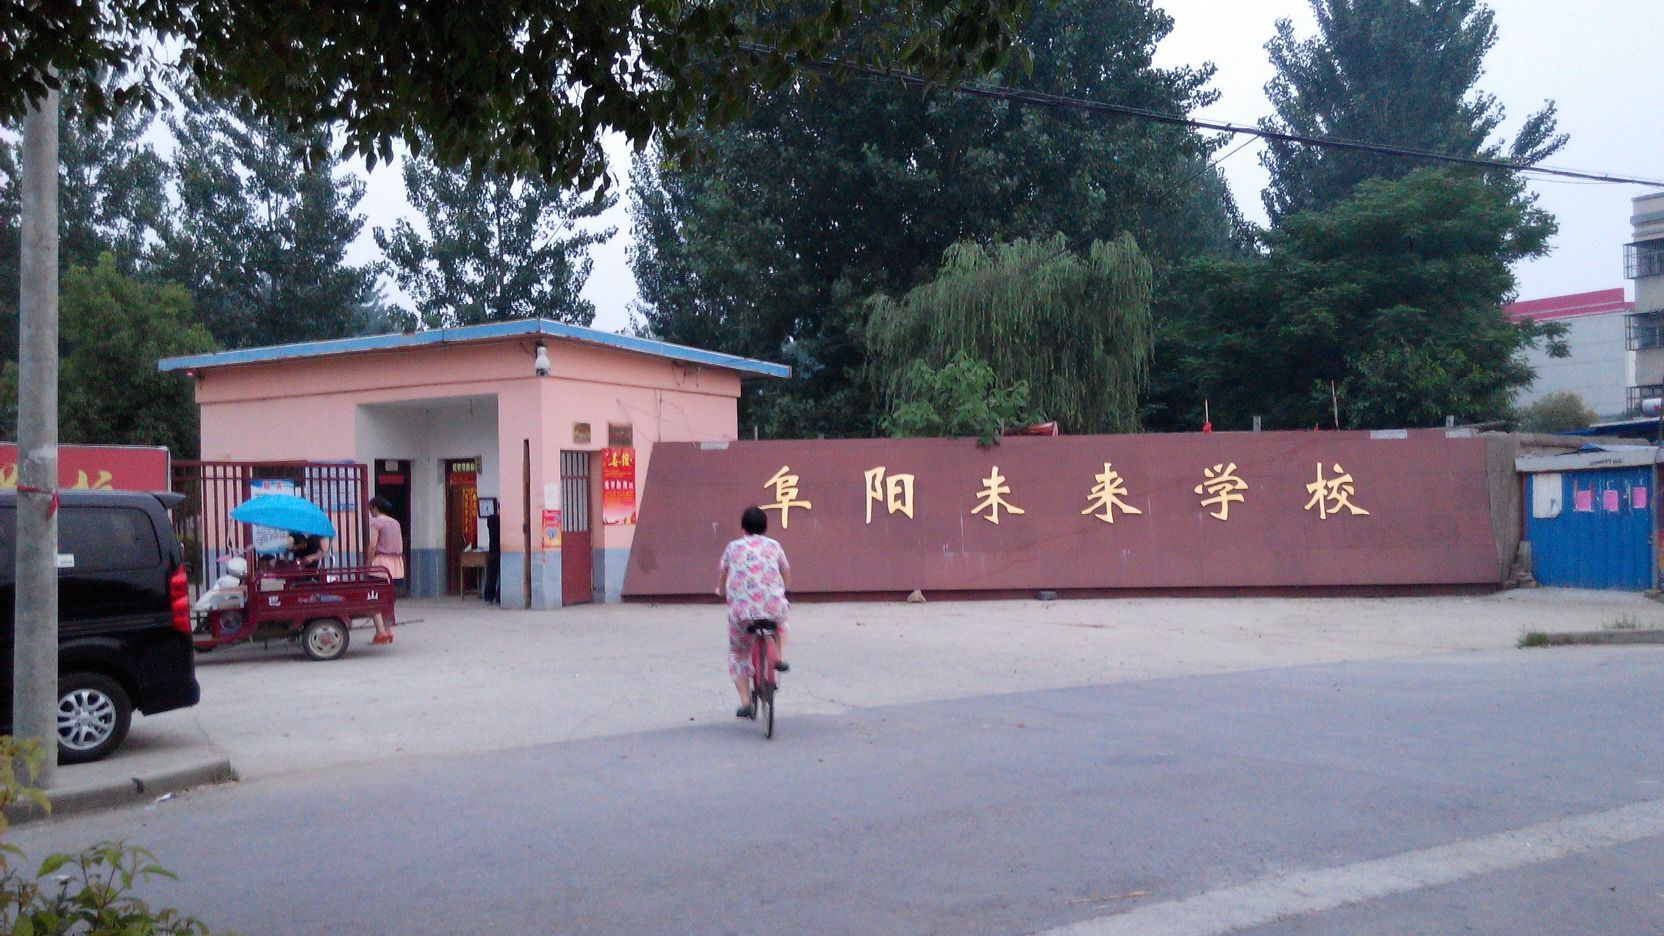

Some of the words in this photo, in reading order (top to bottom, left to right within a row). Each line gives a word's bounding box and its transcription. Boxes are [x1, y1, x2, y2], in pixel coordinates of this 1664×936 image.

[760, 462, 1370, 529] 阜阳未来学校
